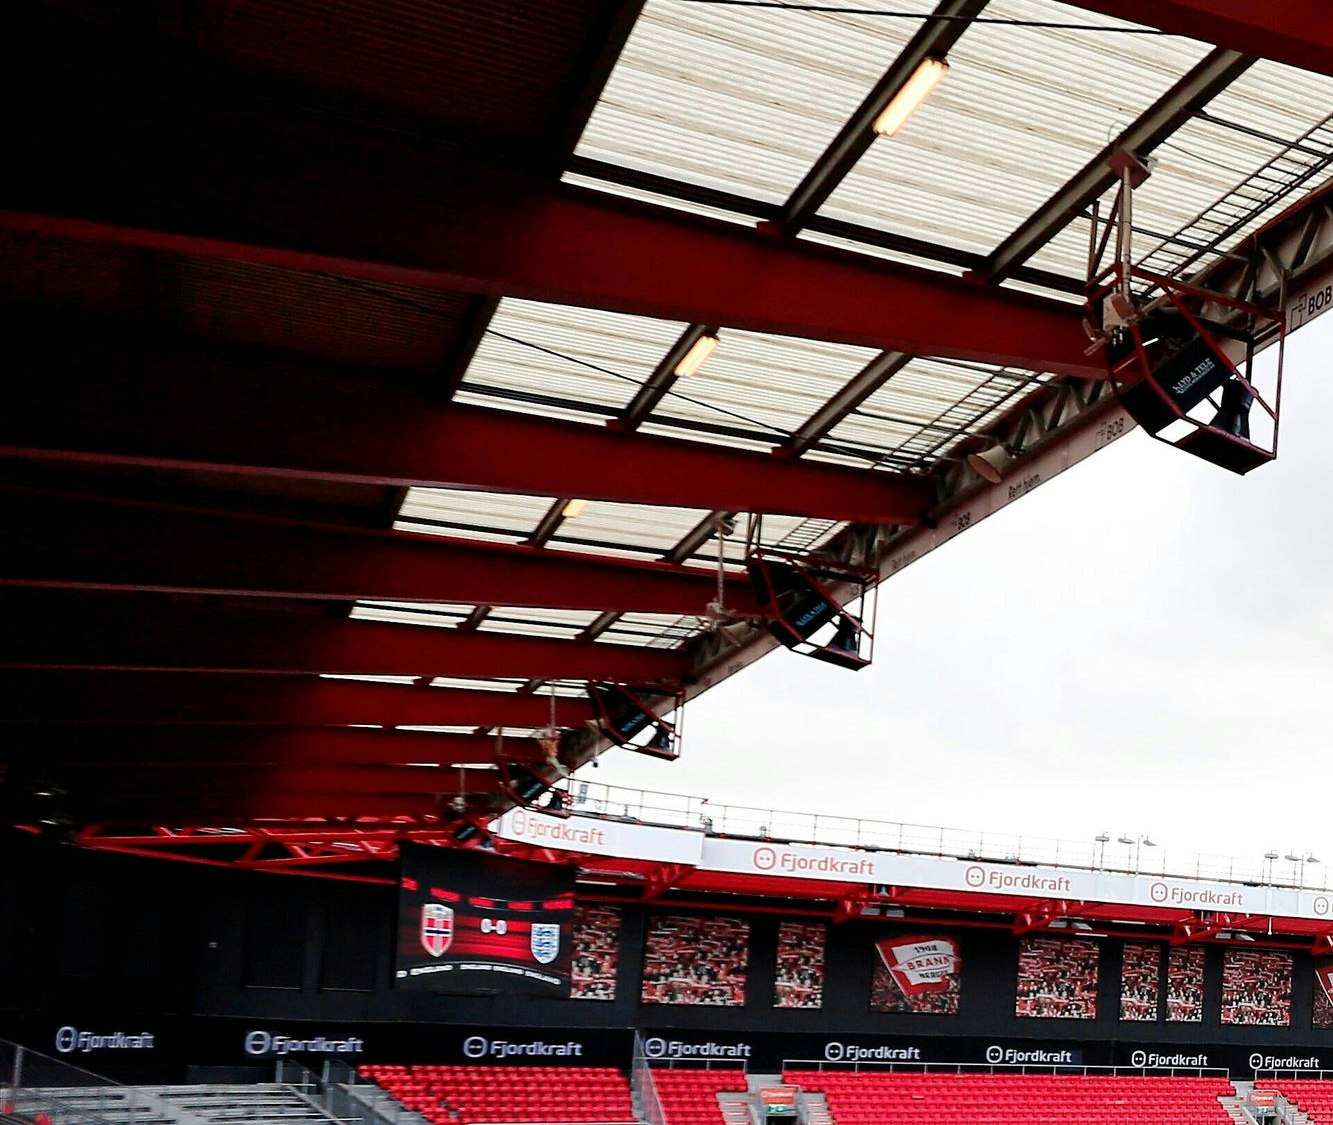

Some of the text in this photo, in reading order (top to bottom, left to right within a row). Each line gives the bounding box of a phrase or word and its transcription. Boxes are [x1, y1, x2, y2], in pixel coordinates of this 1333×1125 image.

[1307, 286, 1332, 316] BOB
[527, 817, 605, 846] Fjordkraft
[780, 853, 875, 876] Fjordkraft
[989, 871, 1072, 892] Fjordkraft
[1171, 886, 1243, 907] Fjordkraft
[78, 1031, 154, 1052] Fjordkraft
[272, 1035, 363, 1054] Fjordkraft
[490, 1040, 582, 1058] Fjordkraft
[668, 1040, 751, 1057] Fjordkraft
[846, 1045, 920, 1061] Fjordkraft
[1005, 1048, 1072, 1064] Fjordkraft
[1148, 1052, 1208, 1068] Fjordkraft
[1264, 1055, 1319, 1070] Fjordkraft
